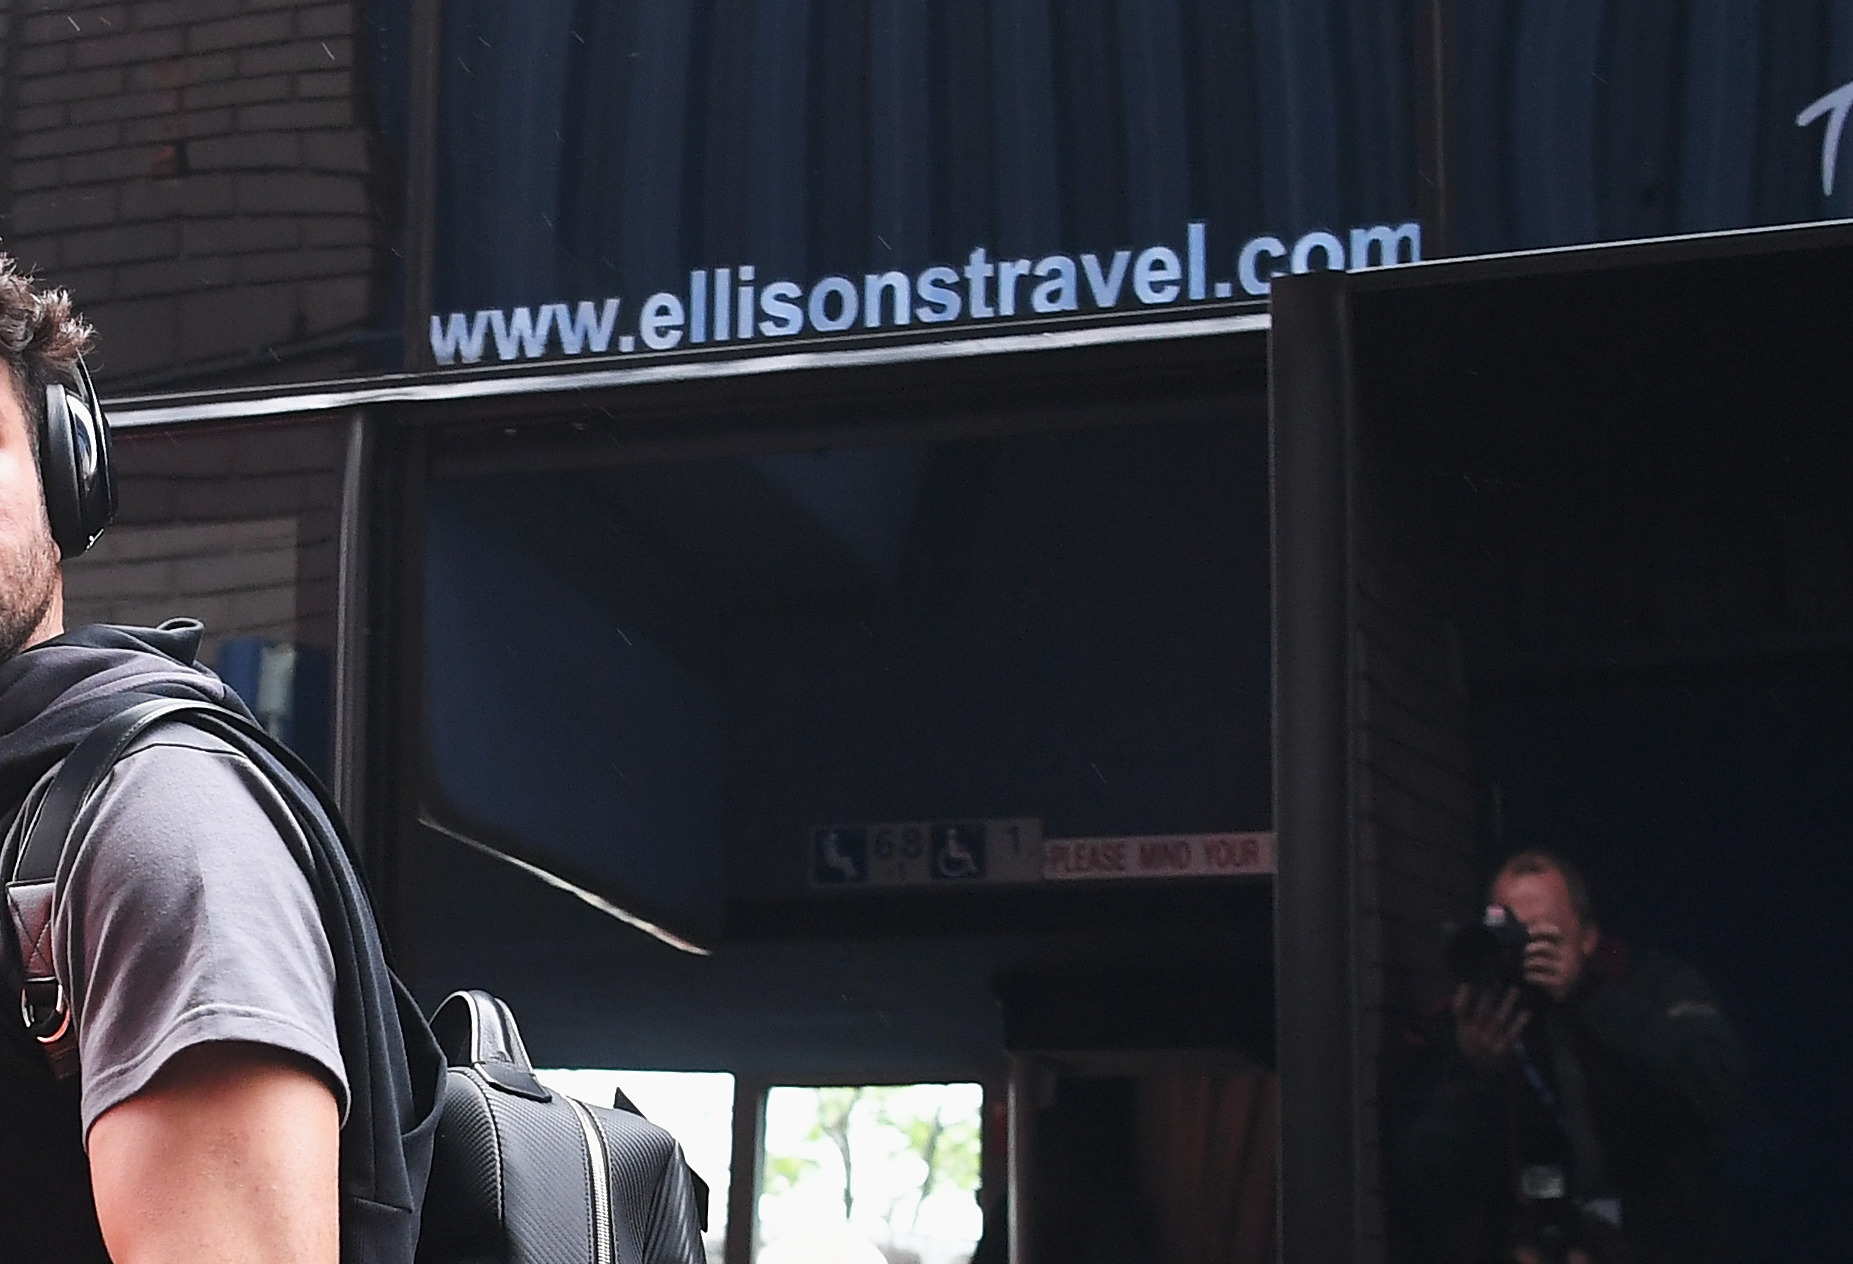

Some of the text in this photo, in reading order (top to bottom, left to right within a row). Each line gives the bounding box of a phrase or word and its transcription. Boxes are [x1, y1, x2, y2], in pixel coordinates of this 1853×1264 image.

[429, 222, 1421, 366] www.ellisonstravel.com
[1050, 838, 1261, 872] PLEASE MIND YOUR
